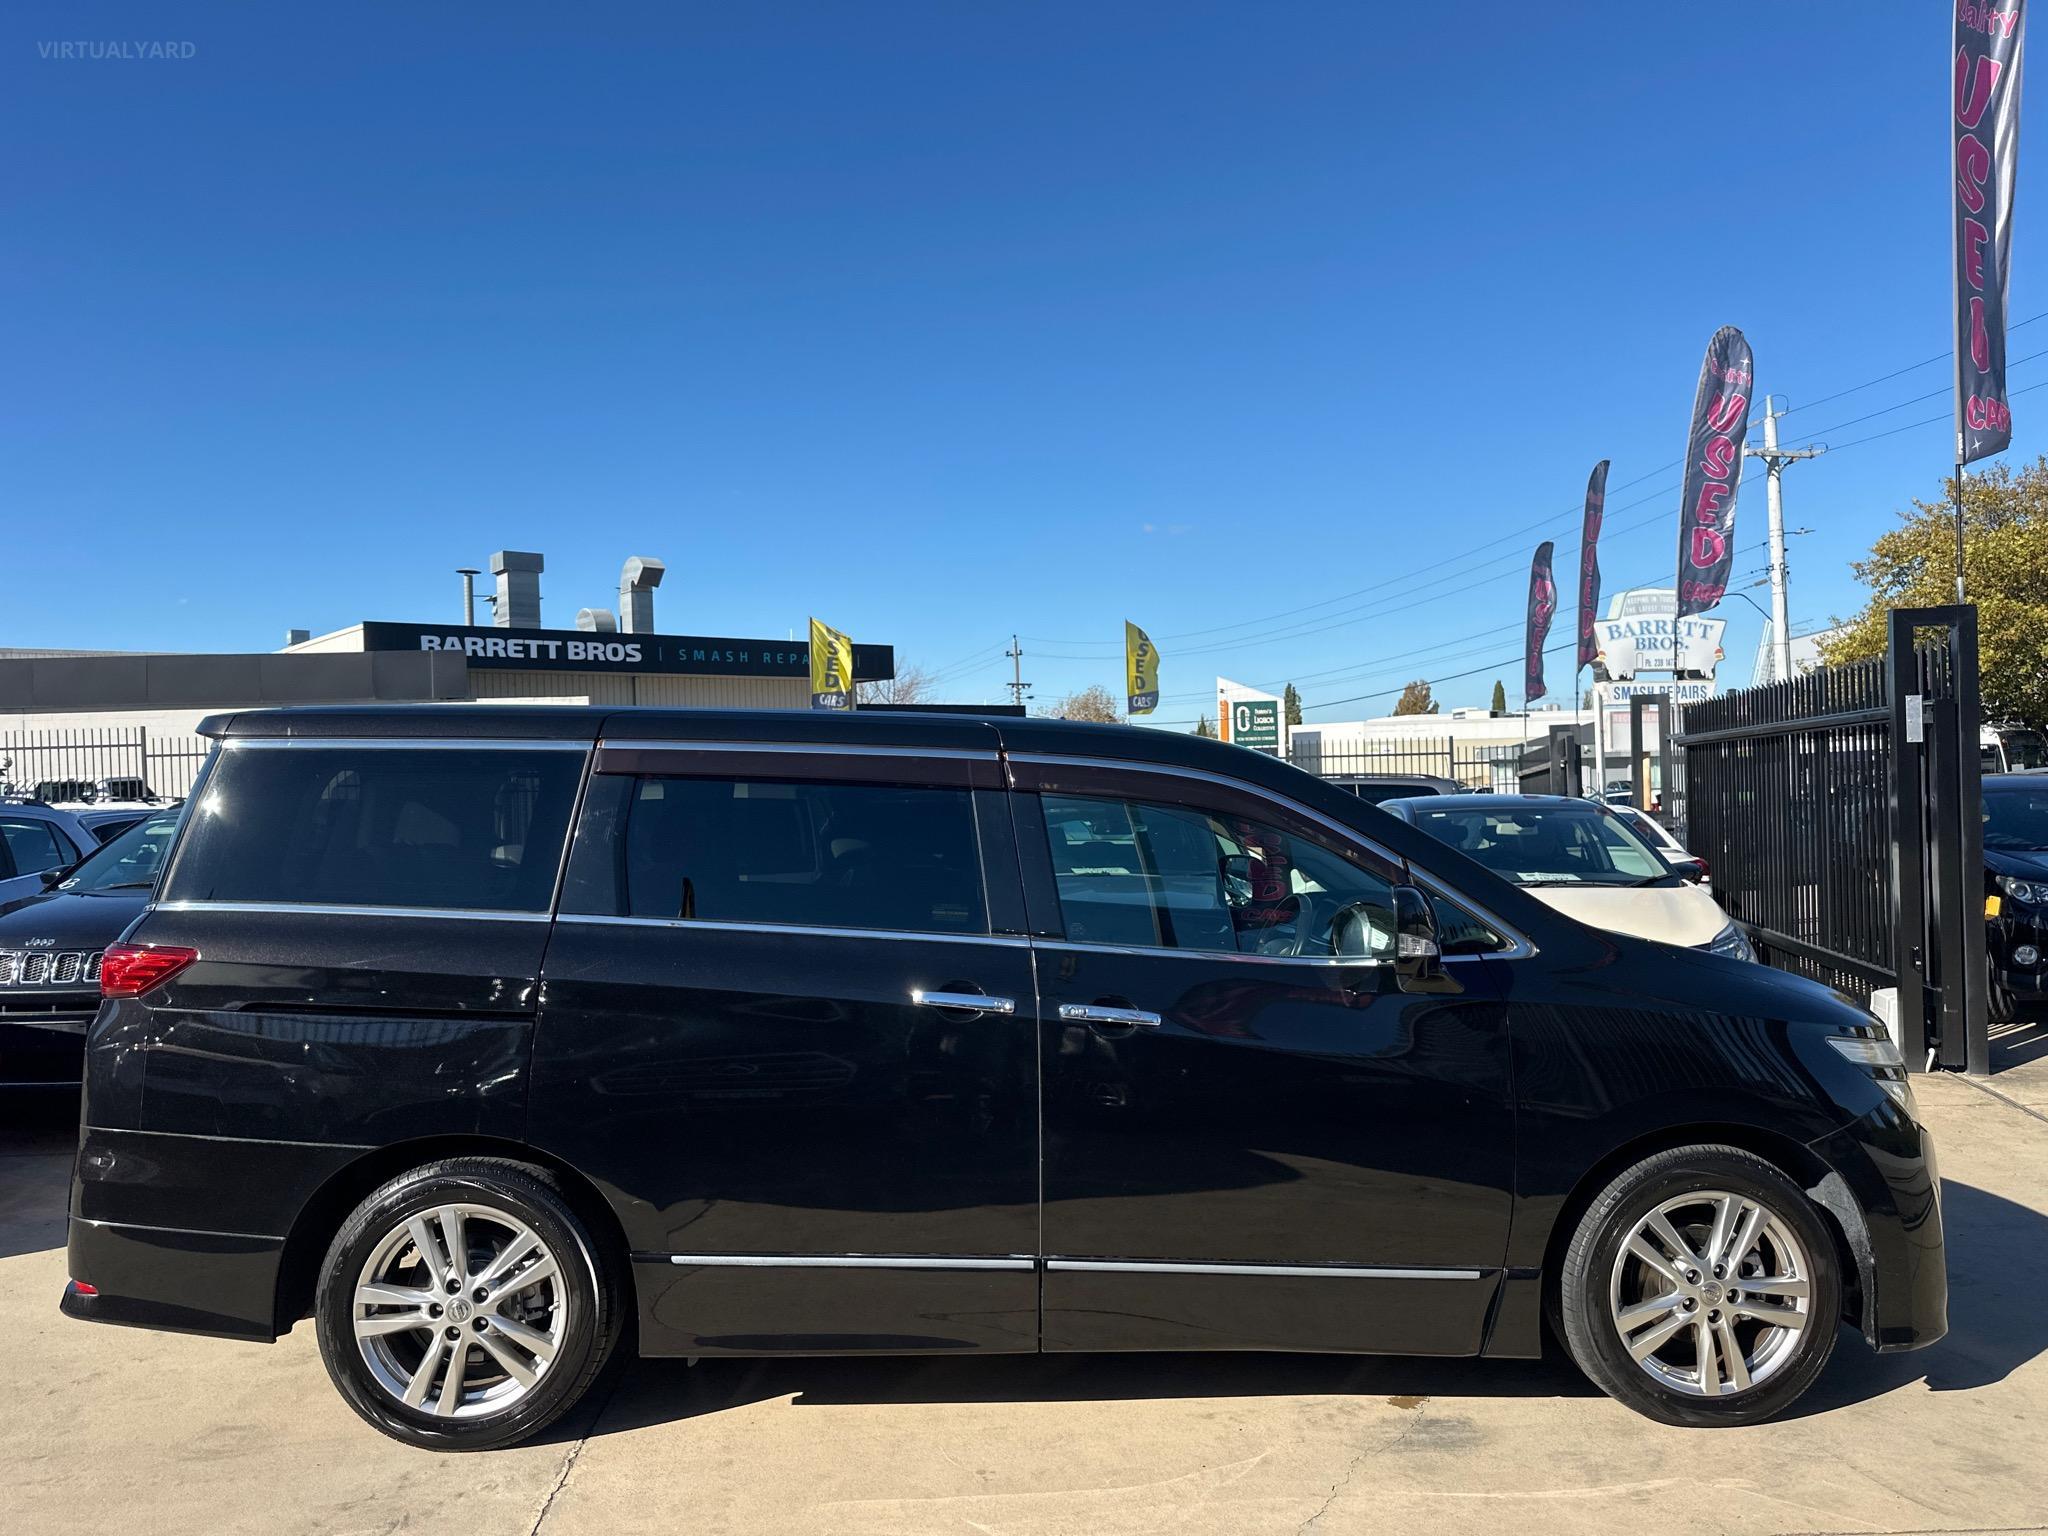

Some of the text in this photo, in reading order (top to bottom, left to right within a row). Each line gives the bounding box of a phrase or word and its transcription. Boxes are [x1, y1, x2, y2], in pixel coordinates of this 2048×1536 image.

[1690, 392, 1747, 569] USED
[1607, 620, 1714, 641] BARRETT
[420, 635, 642, 663] BARRETT BROS
[1635, 637, 1689, 651] BROS.
[679, 648, 809, 665] SMASH REPA
[819, 693, 846, 708] CARS
[24, 937, 56, 947] Jeep
